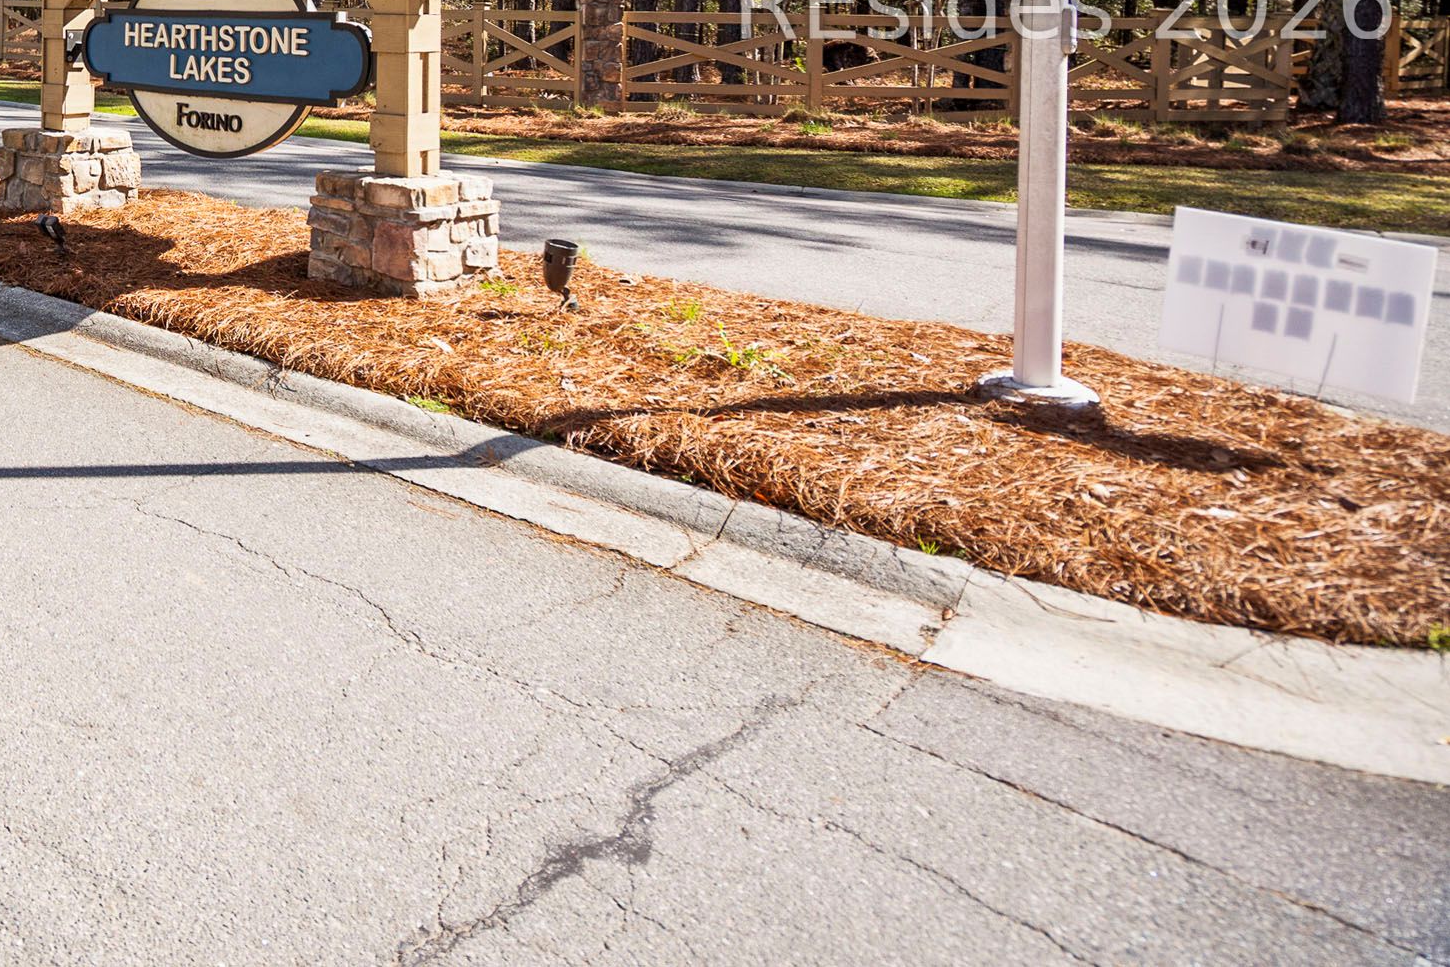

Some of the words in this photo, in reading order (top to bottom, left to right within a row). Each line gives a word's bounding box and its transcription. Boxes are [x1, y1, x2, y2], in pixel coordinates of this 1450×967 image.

[124, 22, 309, 56] HEARTHSTONE
[169, 54, 252, 84] LAKES
[176, 102, 242, 132] FORINO
